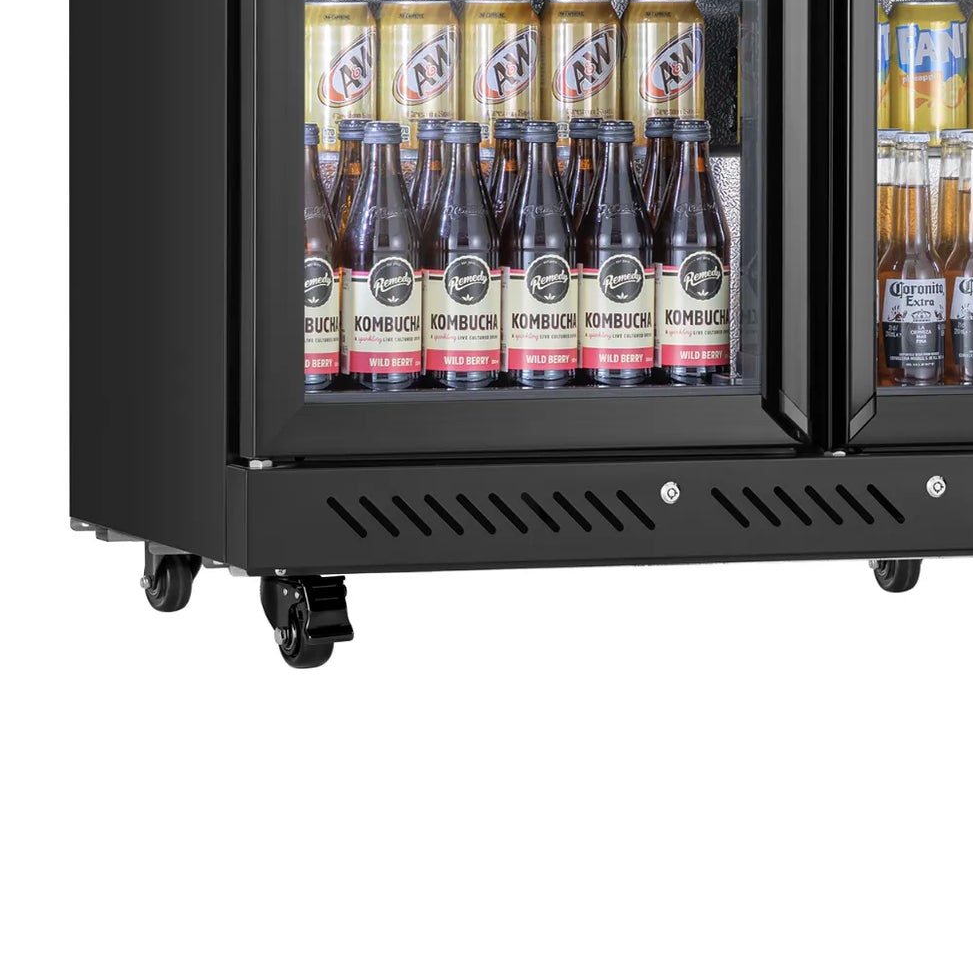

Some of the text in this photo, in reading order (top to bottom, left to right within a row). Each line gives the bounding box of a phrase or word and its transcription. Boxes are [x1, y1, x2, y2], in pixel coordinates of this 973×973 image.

[413, 32, 456, 97] A&W
[493, 30, 536, 96] A&W
[571, 31, 616, 95] A&W
[305, 272, 332, 294] emedy
[373, 271, 412, 297] Remedy
[448, 270, 488, 295] Remedy
[531, 269, 568, 294] Remedy
[603, 268, 642, 294] Remedy
[683, 266, 721, 291] Remedy
[889, 280, 944, 298] Coronita
[906, 295, 934, 307] Extra
[431, 313, 498, 330] KOMBUCHA
[512, 313, 577, 329] KOMBUCHA
[585, 312, 652, 328] KOMBUCHA
[665, 309, 730, 325] KOMBUCHA
[311, 358, 333, 368] BERRY
[369, 357, 413, 367] WILD BERRY
[444, 355, 490, 366] WILD BERRY
[526, 354, 569, 365] WILD BERRY
[599, 353, 643, 363] WILD BERRY
[680, 350, 723, 360] WILD BERRY
